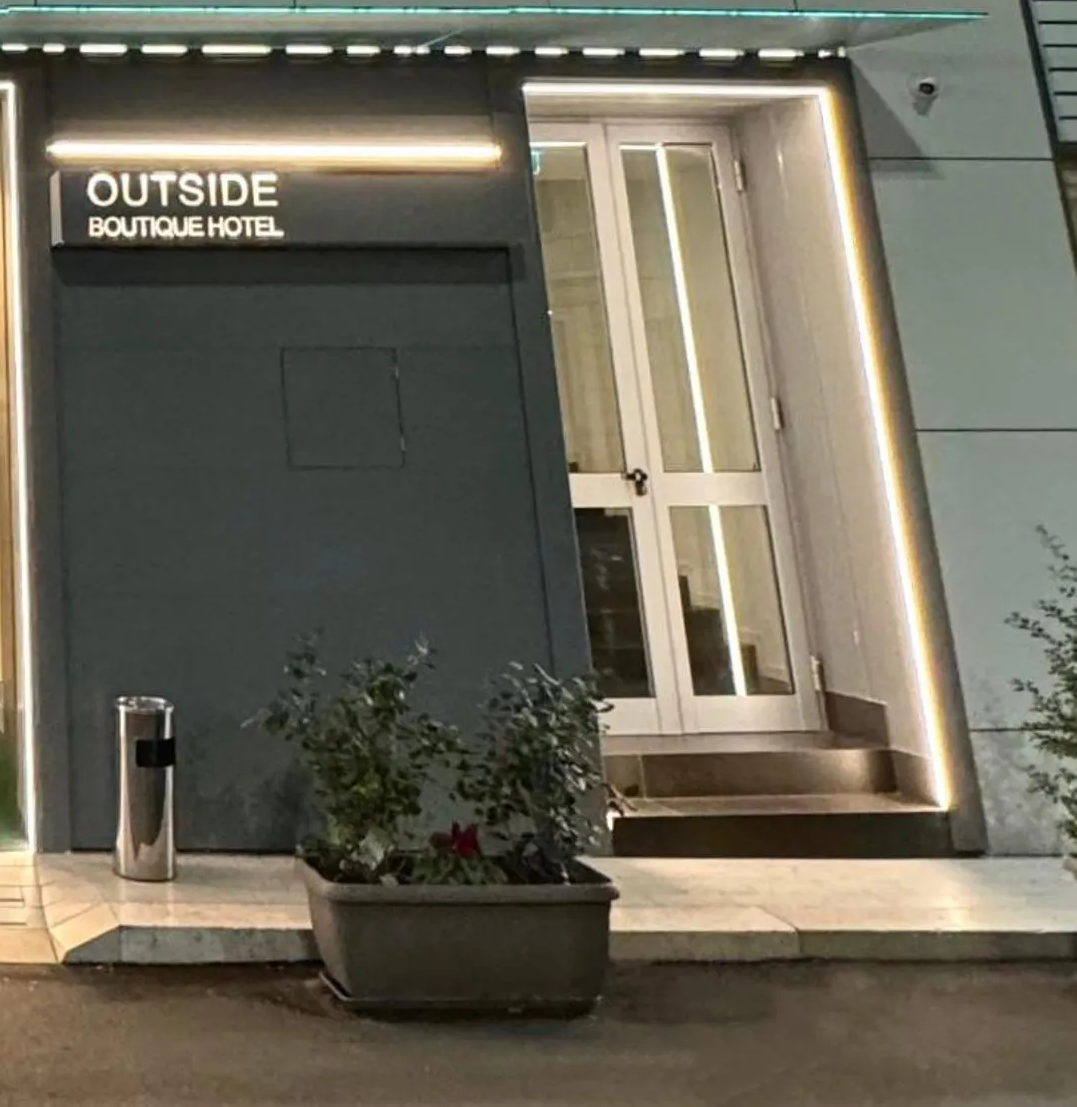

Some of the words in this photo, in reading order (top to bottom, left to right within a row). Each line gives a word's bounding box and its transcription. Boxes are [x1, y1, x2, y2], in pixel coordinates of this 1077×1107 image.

[86, 171, 279, 207] OUTSIDE
[88, 215, 205, 238] BOUTIQUE
[208, 215, 284, 238] HOTEL
